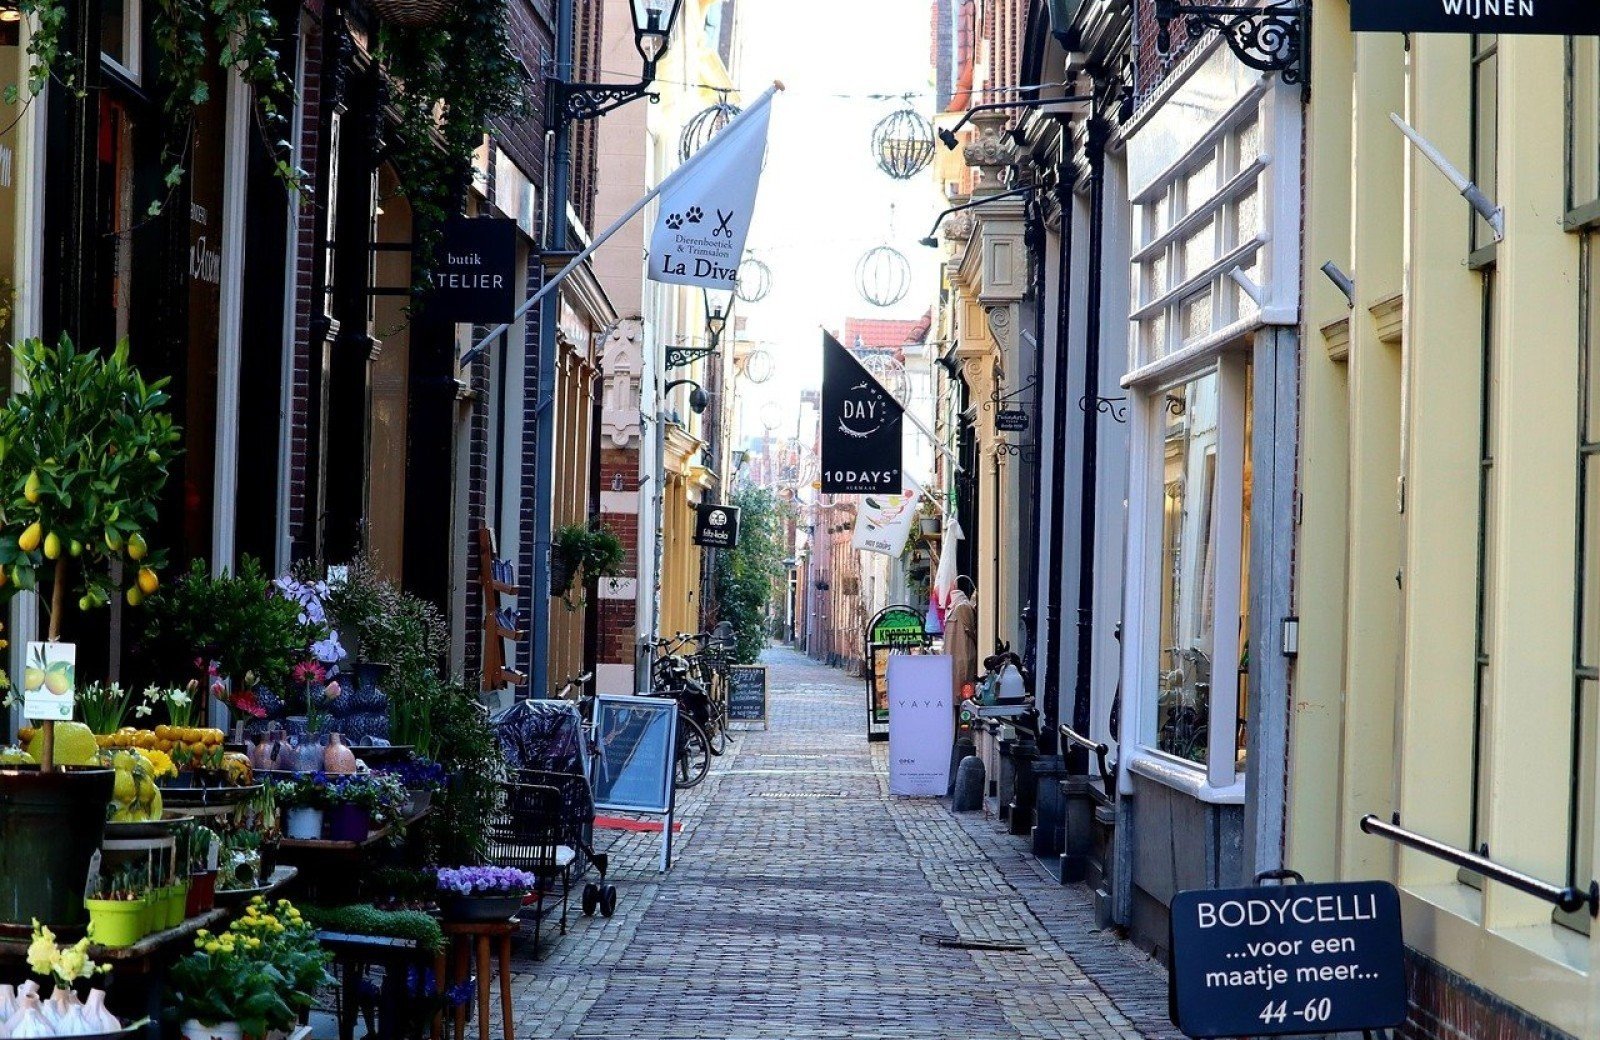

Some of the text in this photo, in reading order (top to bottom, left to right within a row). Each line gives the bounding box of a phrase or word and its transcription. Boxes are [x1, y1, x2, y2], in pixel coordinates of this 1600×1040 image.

[1442, 0, 1534, 20] WIJNEN
[675, 234, 733, 250] Dierenboetiek
[677, 245, 729, 259] & Trimsalon
[448, 252, 481, 265] butik
[662, 254, 737, 281] La Diva
[844, 400, 877, 419] DAY
[1197, 894, 1377, 929] BODYCELLI
[1225, 937, 1356, 960] ...voor een
[1205, 963, 1379, 991] maatje meer...
